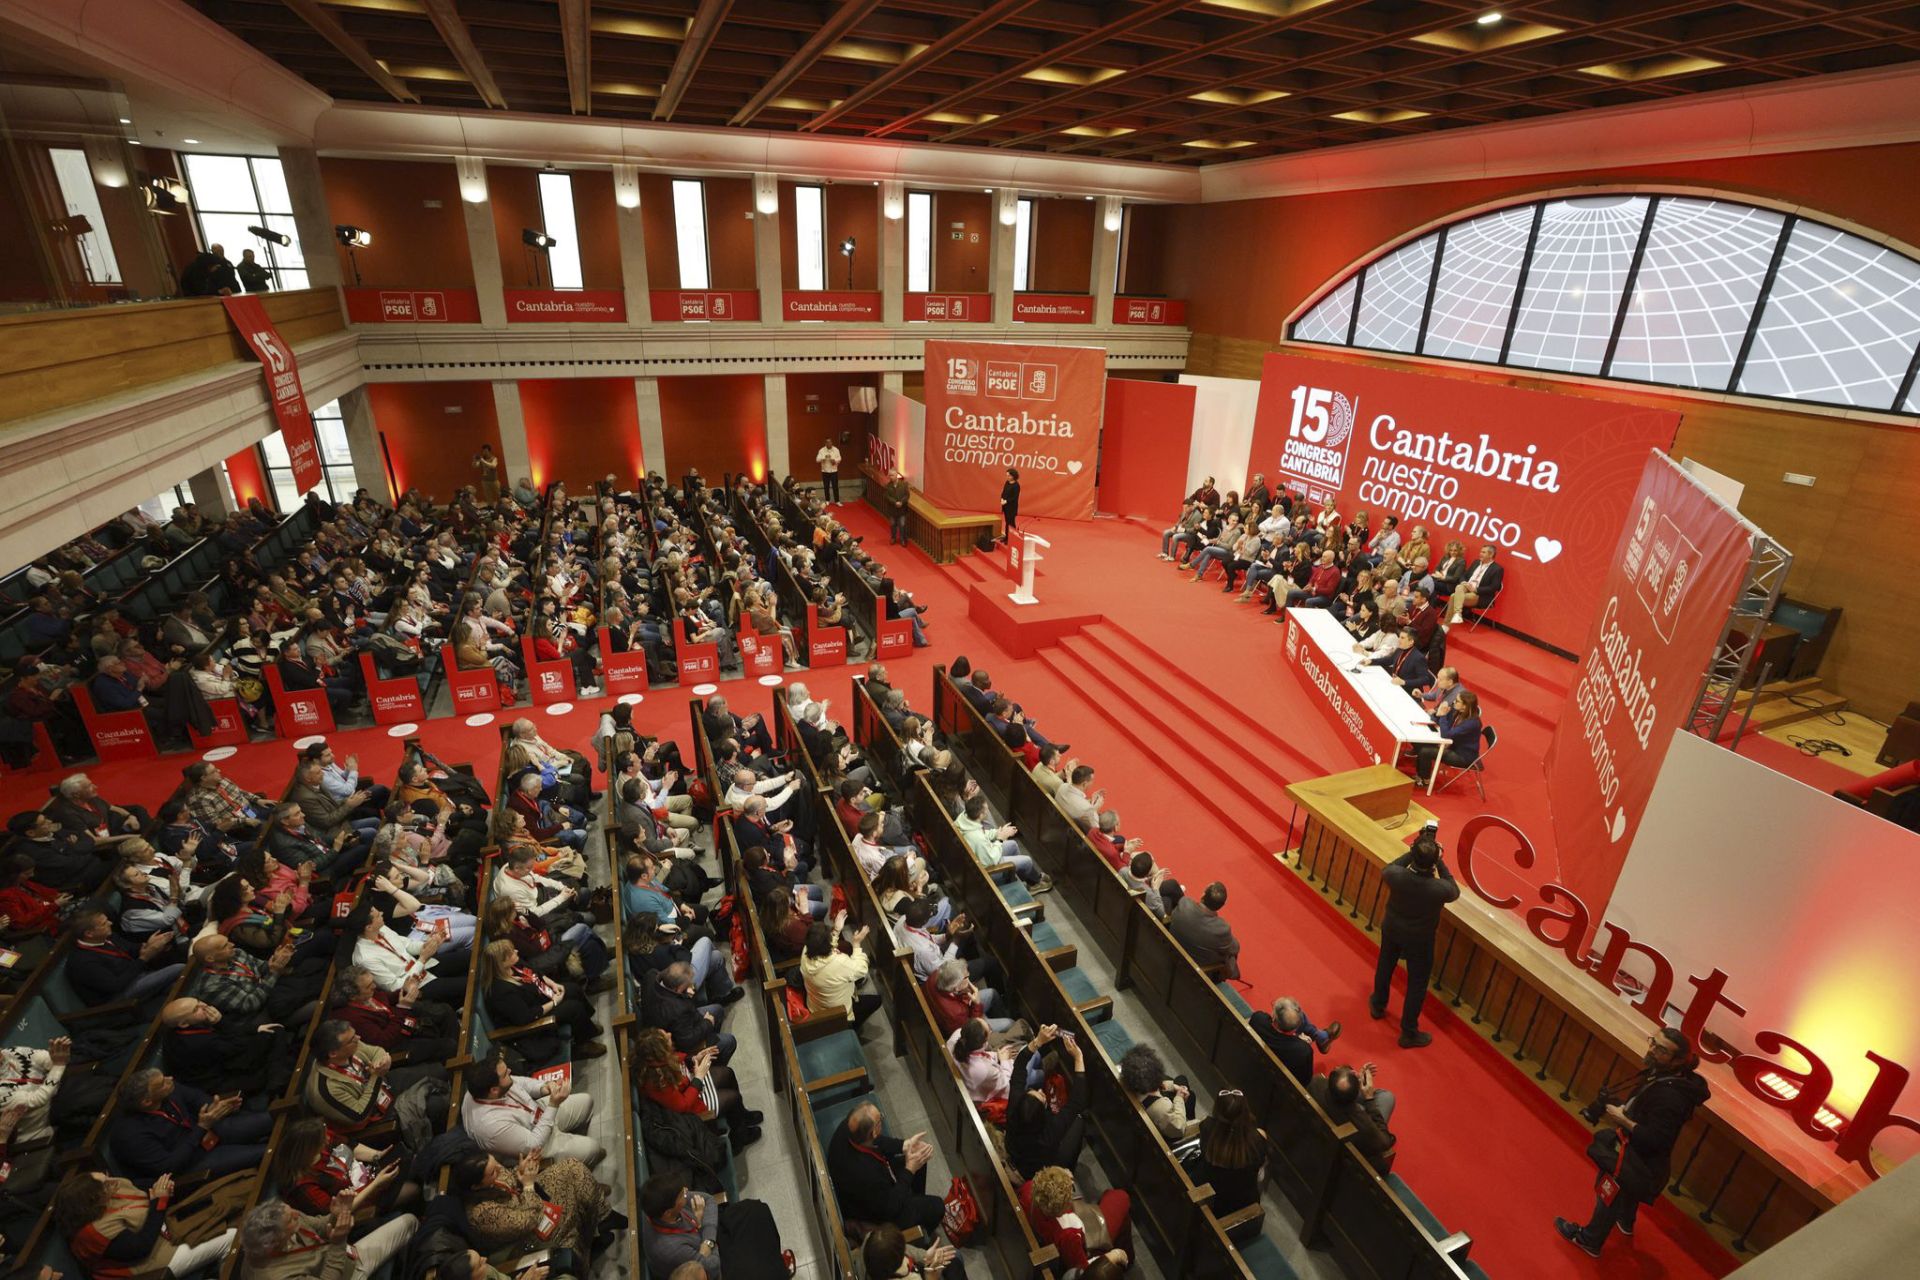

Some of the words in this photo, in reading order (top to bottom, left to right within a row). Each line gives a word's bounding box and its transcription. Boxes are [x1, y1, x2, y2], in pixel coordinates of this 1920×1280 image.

[385, 306, 412, 315] PSOE
[517, 300, 574, 312] Cantabria
[682, 306, 704, 314] PSOE
[790, 301, 838, 312] Cantabria
[927, 307, 944, 315] PSOE
[1018, 304, 1056, 314] Cantabria
[1130, 310, 1145, 319] PSOE
[252, 332, 284, 373] 15
[947, 358, 967, 378] 15
[989, 370, 1017, 378] Cantabria
[947, 384, 976, 392] CANTABRIA
[948, 378, 976, 386] CONGRESO
[989, 378, 1017, 390] PSOE
[1290, 385, 1333, 443] 15
[945, 406, 1074, 438] Cantabria
[945, 433, 1015, 452] nuestro
[869, 432, 896, 476] PSOE
[1285, 439, 1342, 467] CONGRESO
[1370, 414, 1560, 493] Cantabria
[1280, 454, 1340, 484] CANTABRIA
[1362, 456, 1459, 500] nuestro
[1635, 496, 1656, 541] 15
[1644, 554, 1663, 593] PSOE
[813, 641, 843, 650] Cantabria
[608, 666, 643, 675] Cantabria
[1600, 596, 1657, 751] Cantabria
[540, 672, 554, 683] 15
[1300, 644, 1342, 714] Cantabria
[1586, 647, 1616, 725] nuestro
[376, 693, 416, 703] Cantabria
[291, 702, 308, 714] 15
[1343, 701, 1364, 730] nuestro
[96, 727, 144, 739] Cantabria
[336, 902, 351, 917] 15
